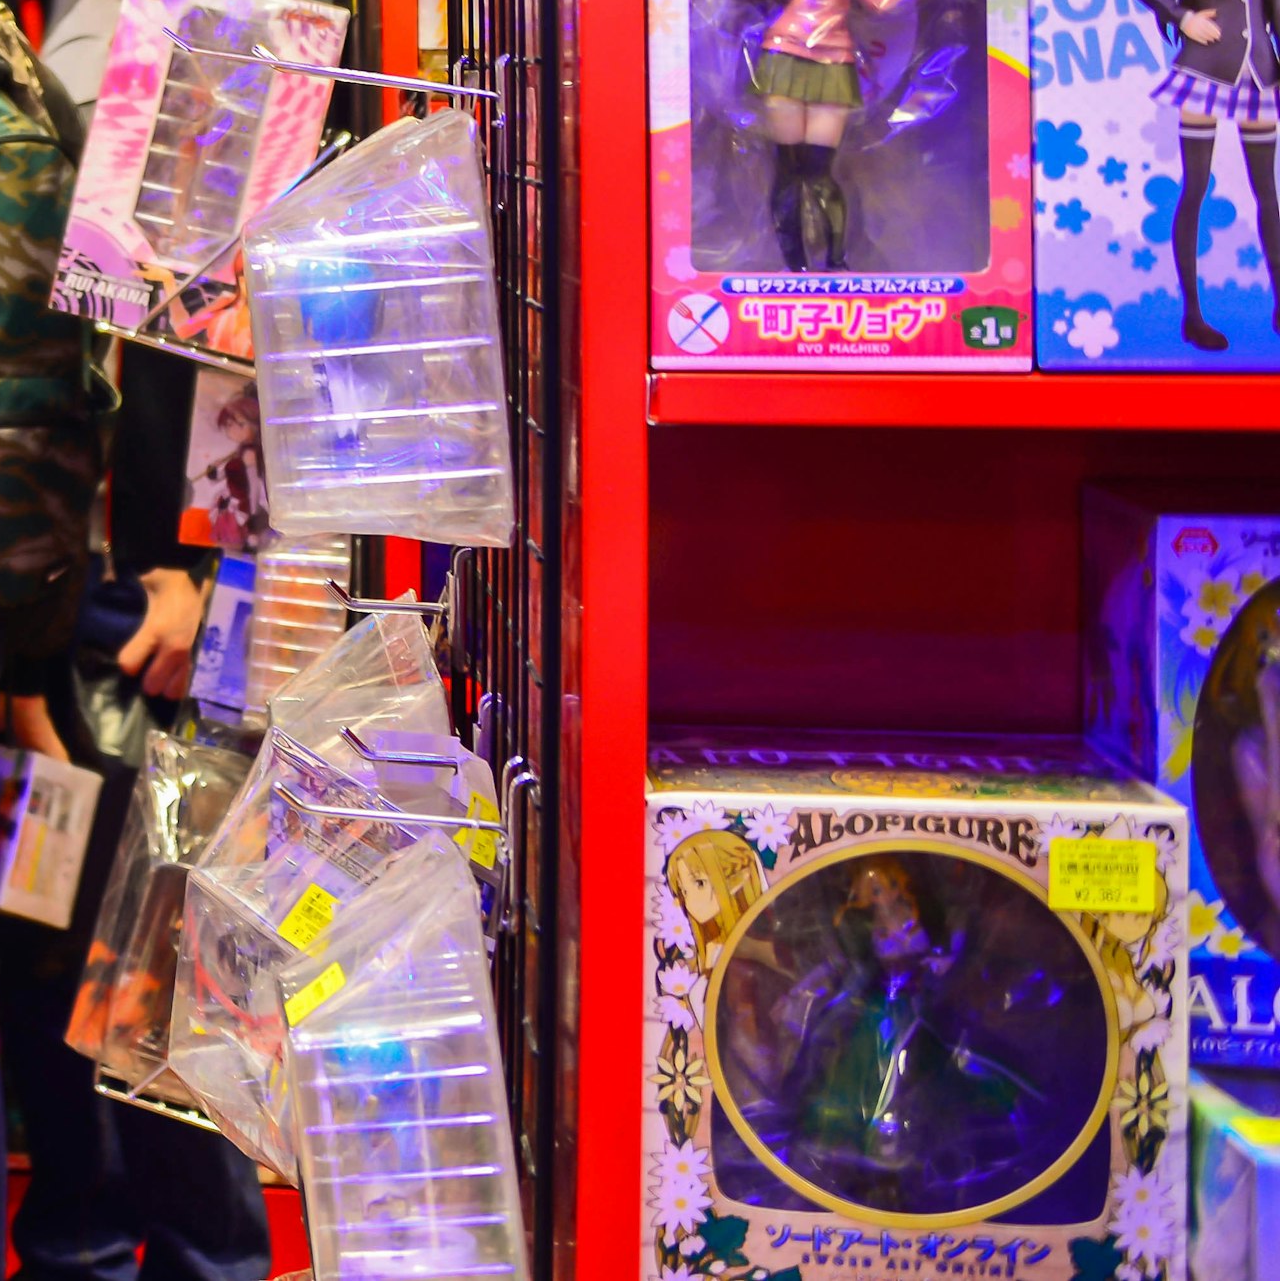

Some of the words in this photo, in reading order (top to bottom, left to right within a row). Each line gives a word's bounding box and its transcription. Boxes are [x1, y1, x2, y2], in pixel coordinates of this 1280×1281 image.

[64, 273, 95, 293] RUI
[95, 280, 151, 307] AKANA
[797, 342, 824, 355] RYO
[828, 342, 890, 355] MACHIKO
[765, 1223, 1053, 1266] ソードアート・オンライン
